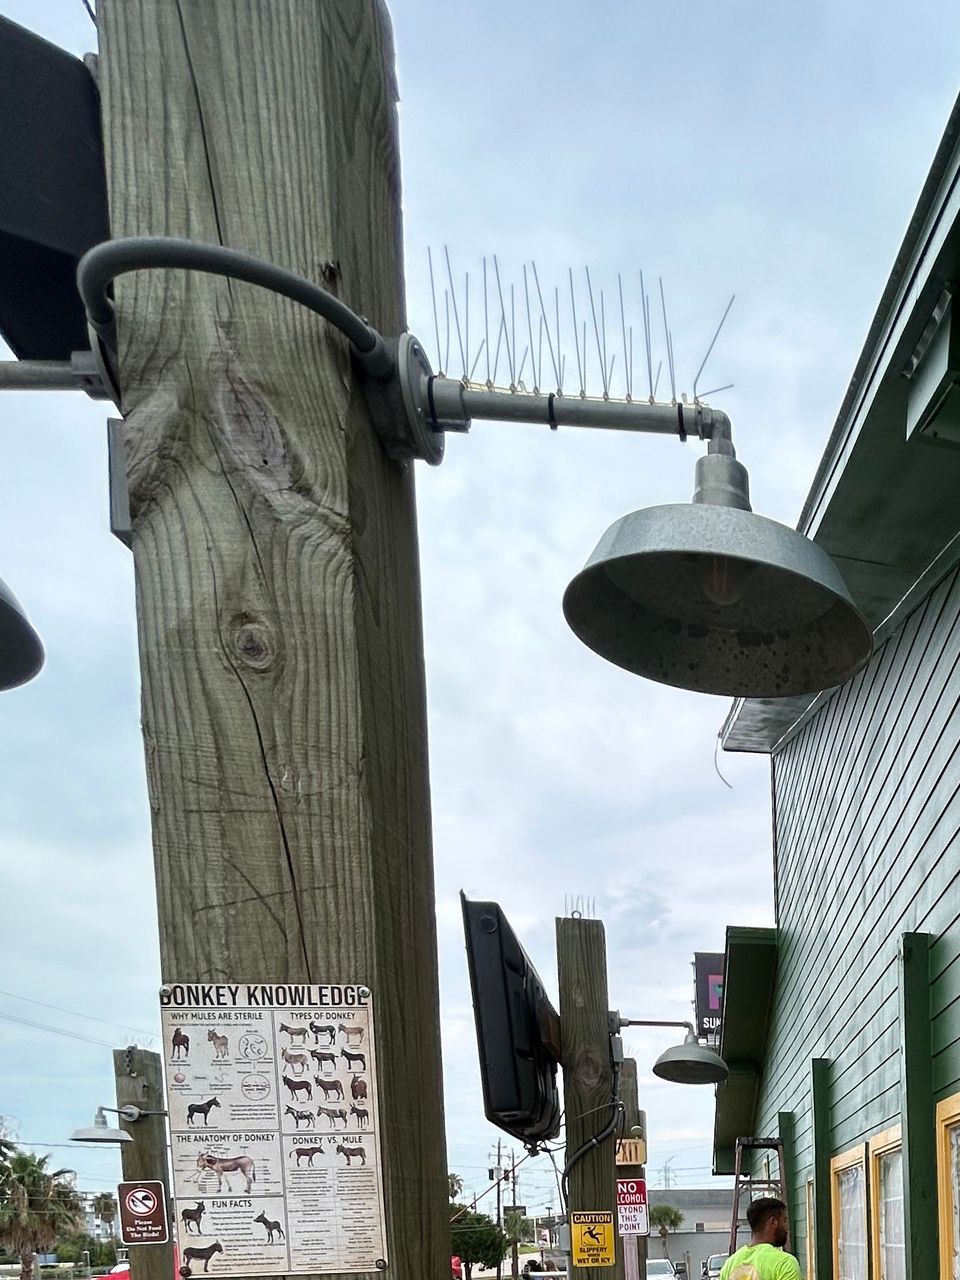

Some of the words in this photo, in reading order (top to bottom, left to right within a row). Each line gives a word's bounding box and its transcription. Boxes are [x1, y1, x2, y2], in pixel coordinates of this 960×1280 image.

[161, 985, 239, 1006] DONKEY
[248, 985, 368, 1006] KNOWLEDGE
[218, 1012, 232, 1020] ARE
[234, 1012, 263, 1020] STERILE
[290, 1012, 311, 1020] TYPES
[314, 1012, 323, 1020] OF
[326, 1012, 355, 1020] DONKEY
[193, 1134, 231, 1142] ANATOMY
[233, 1134, 243, 1142] OF
[293, 1136, 322, 1144] DONKEY
[327, 1136, 339, 1144] VS.
[617, 1142, 639, 1162] XIT
[617, 1182, 637, 1193] NO
[617, 1194, 645, 1203] LCOHOL
[229, 1200, 252, 1208] FACTS
[619, 1206, 643, 1214] EYOND
[574, 1214, 610, 1222] CAUTION
[621, 1214, 637, 1222] THIS
[619, 1223, 640, 1231] POINT
